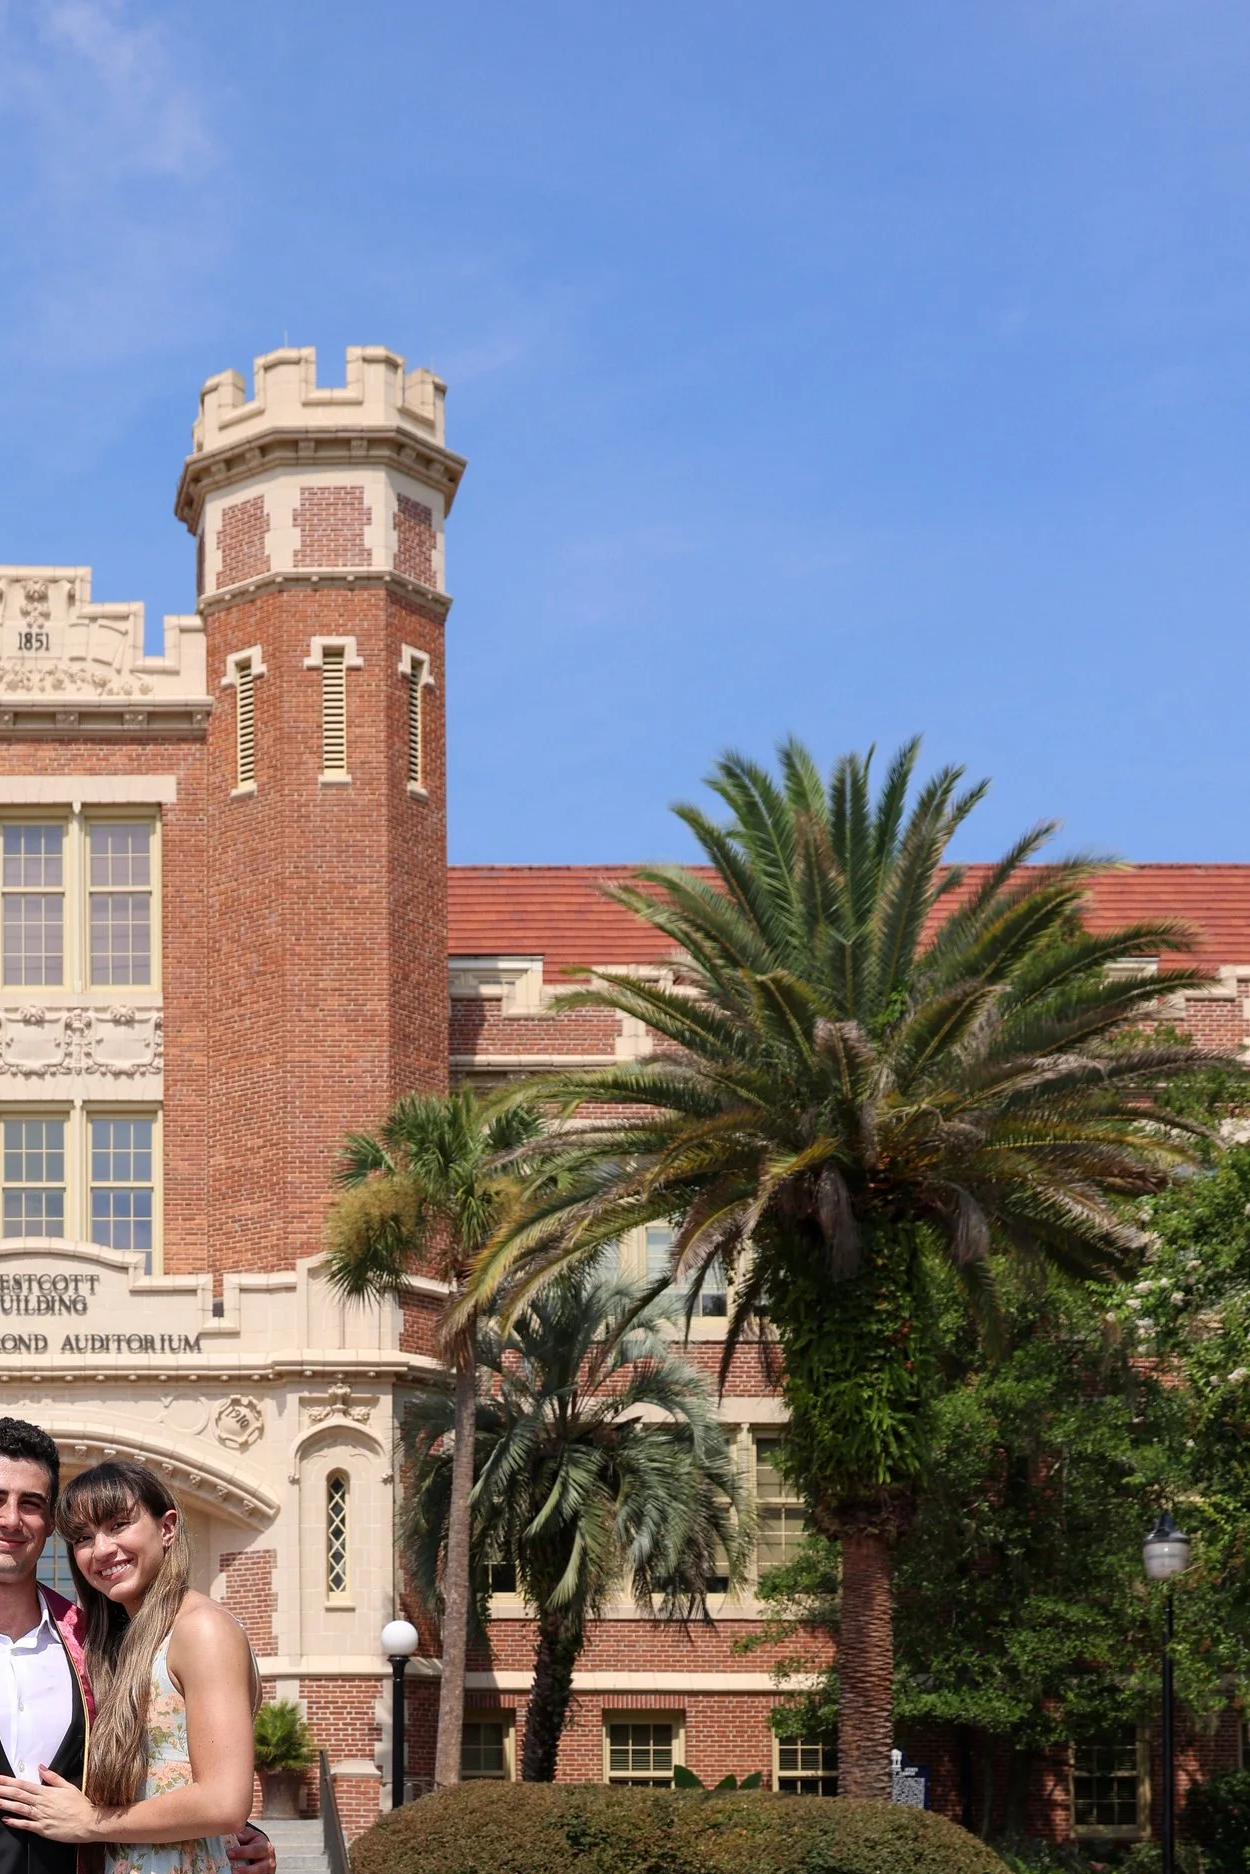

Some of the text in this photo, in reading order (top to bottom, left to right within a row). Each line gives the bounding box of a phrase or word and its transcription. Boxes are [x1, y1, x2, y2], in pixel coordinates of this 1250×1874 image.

[18, 631, 50, 651] 1851
[61, 1333, 203, 1354] AUDITORIUM
[225, 1407, 250, 1429] 1910
